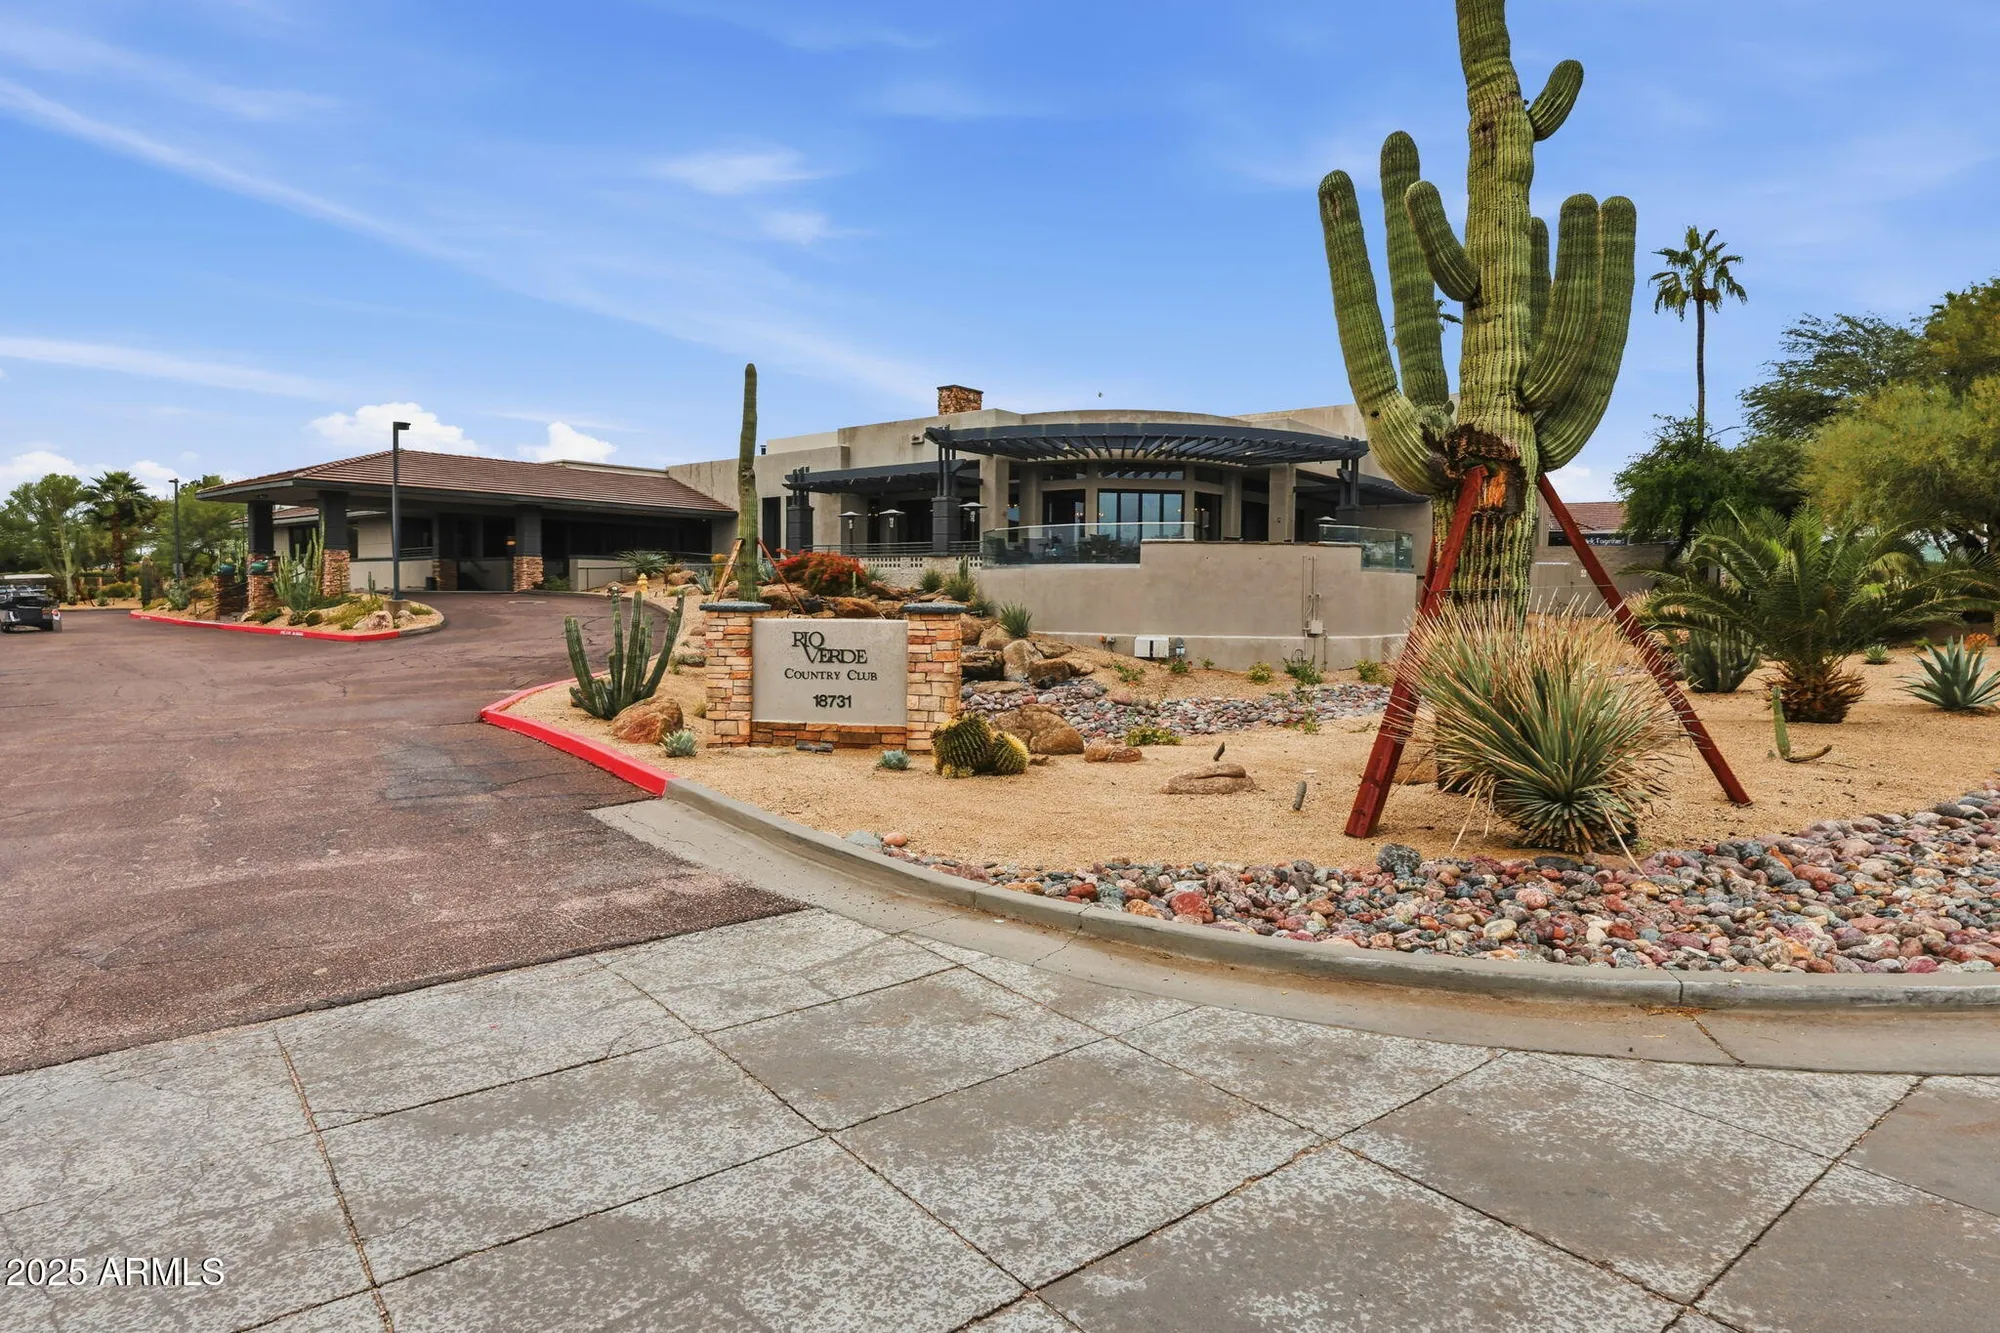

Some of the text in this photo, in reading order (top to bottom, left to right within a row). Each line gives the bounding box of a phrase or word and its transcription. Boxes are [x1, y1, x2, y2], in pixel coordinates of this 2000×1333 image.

[792, 631, 825, 649] RIO
[802, 647, 868, 664] VERDE
[784, 668, 878, 681] COUNTRY CLUB
[813, 694, 852, 708] 18731
